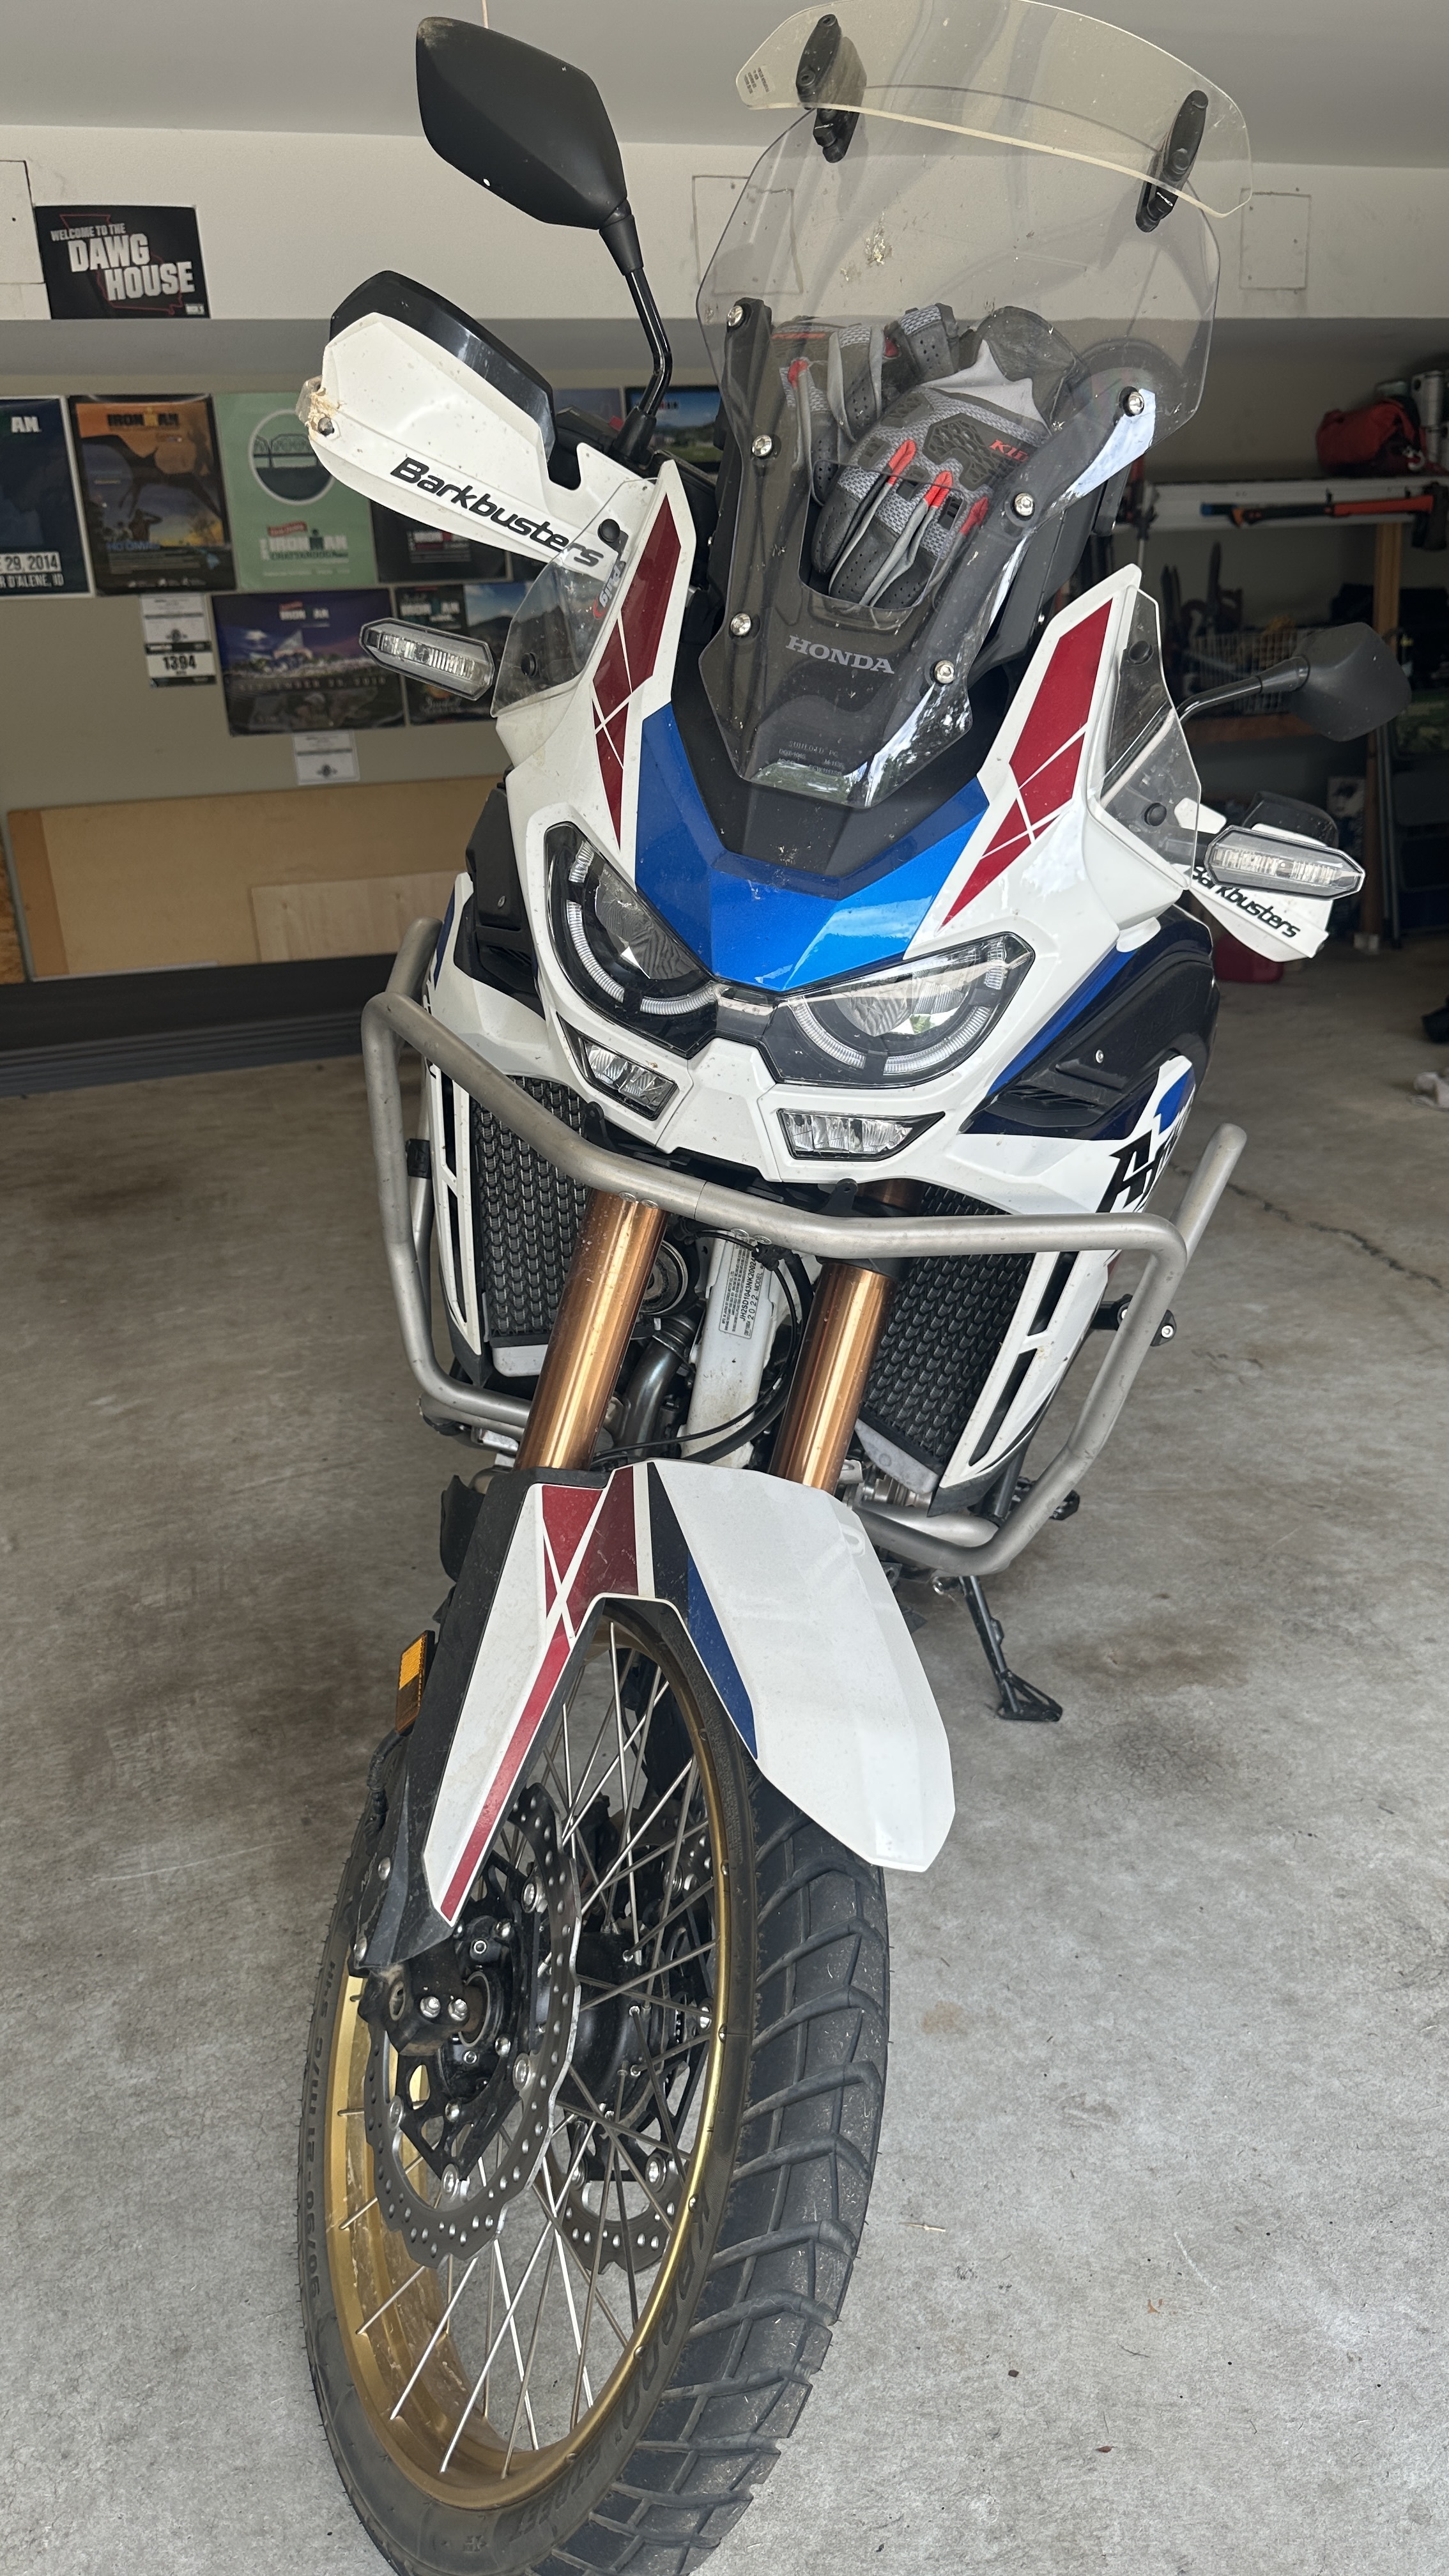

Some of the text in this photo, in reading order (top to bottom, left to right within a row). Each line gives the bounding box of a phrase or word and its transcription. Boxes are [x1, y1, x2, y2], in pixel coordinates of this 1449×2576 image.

[50, 223, 126, 241] WELCOME TO THE
[68, 233, 151, 273] DAWG
[104, 261, 195, 302] HOUSE
[390, 457, 604, 567] Barkbusters
[5, 555, 58, 573] 29, 2014
[163, 655, 197, 670] 1394
[785, 634, 894, 674] HONDA
[748, 1294, 758, 1321] 2022
[754, 1273, 763, 1292] MODEL
